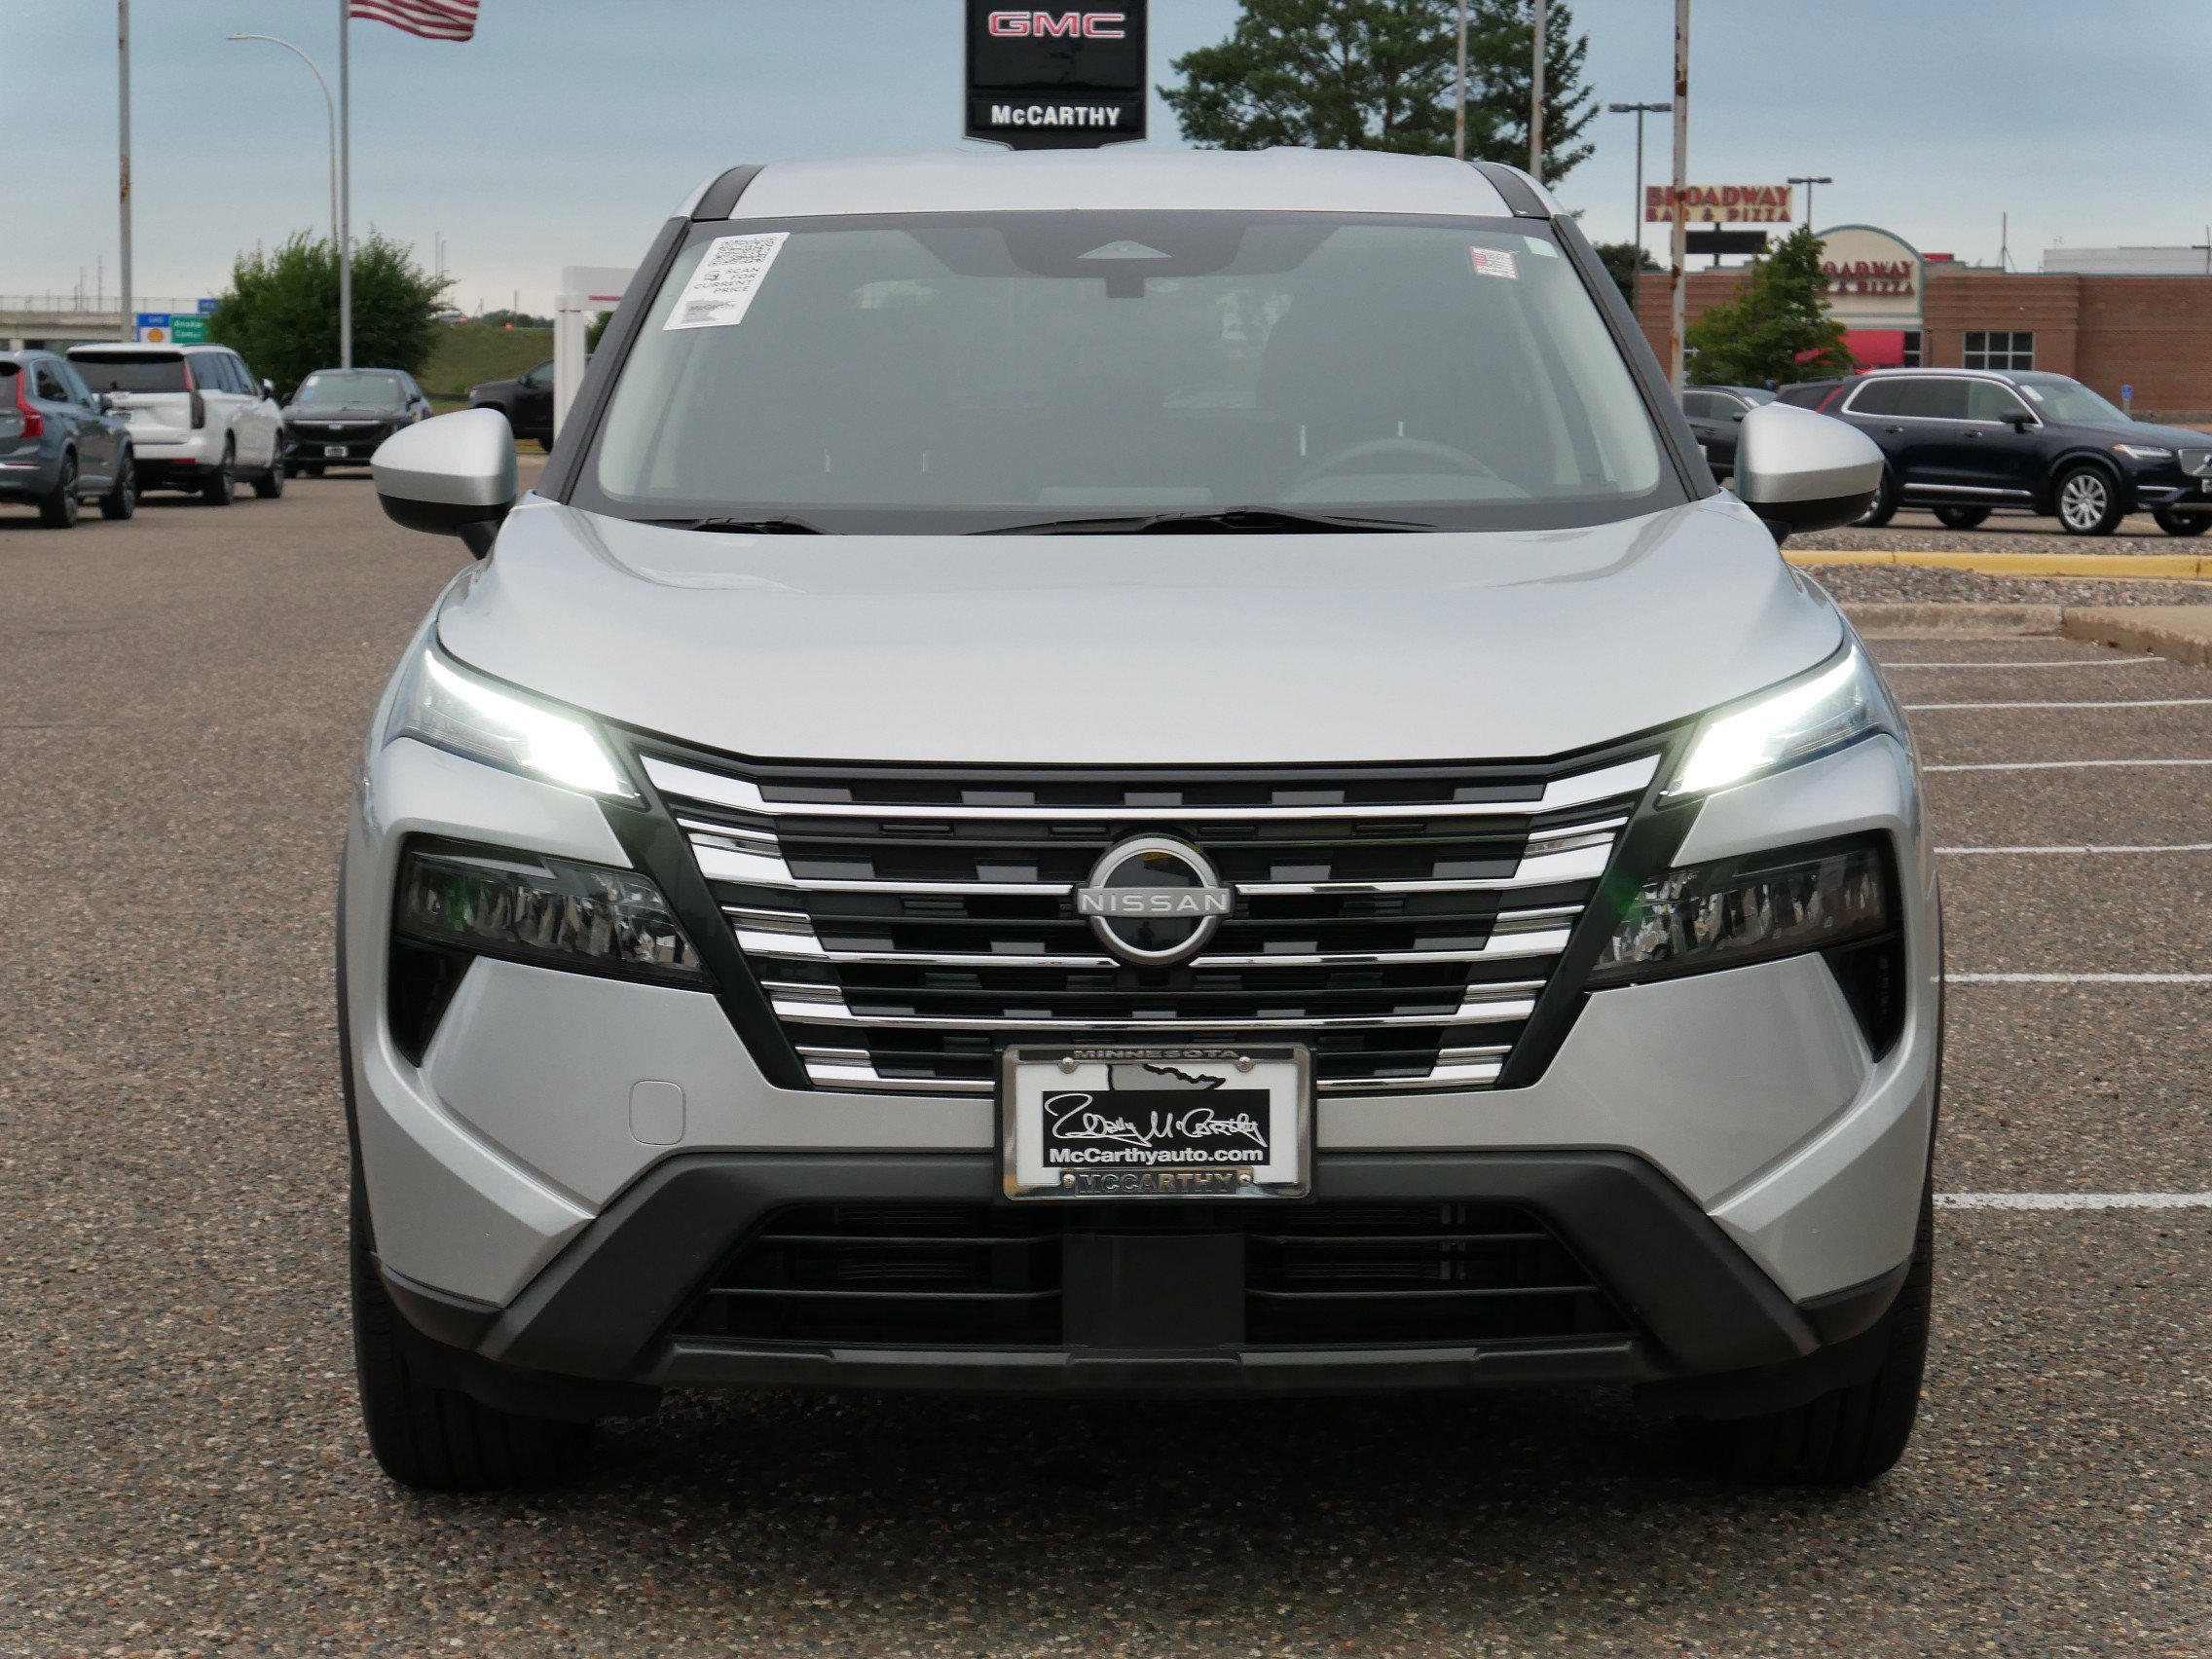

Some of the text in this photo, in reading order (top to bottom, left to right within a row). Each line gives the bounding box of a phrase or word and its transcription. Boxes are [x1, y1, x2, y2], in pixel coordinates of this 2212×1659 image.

[988, 11, 1125, 39] GMC
[990, 104, 1121, 127] McCARTHY
[1645, 207, 1791, 222] BA & PIZZA
[1821, 261, 1913, 279] OADWAY
[693, 279, 756, 289] CURRENT
[1081, 894, 1228, 911] NISSAN
[1073, 1050, 1241, 1059] MINNESOTA
[1049, 1147, 1264, 1165] McCarthyauto.com
[1078, 1173, 1235, 1194] MCCARTHY
